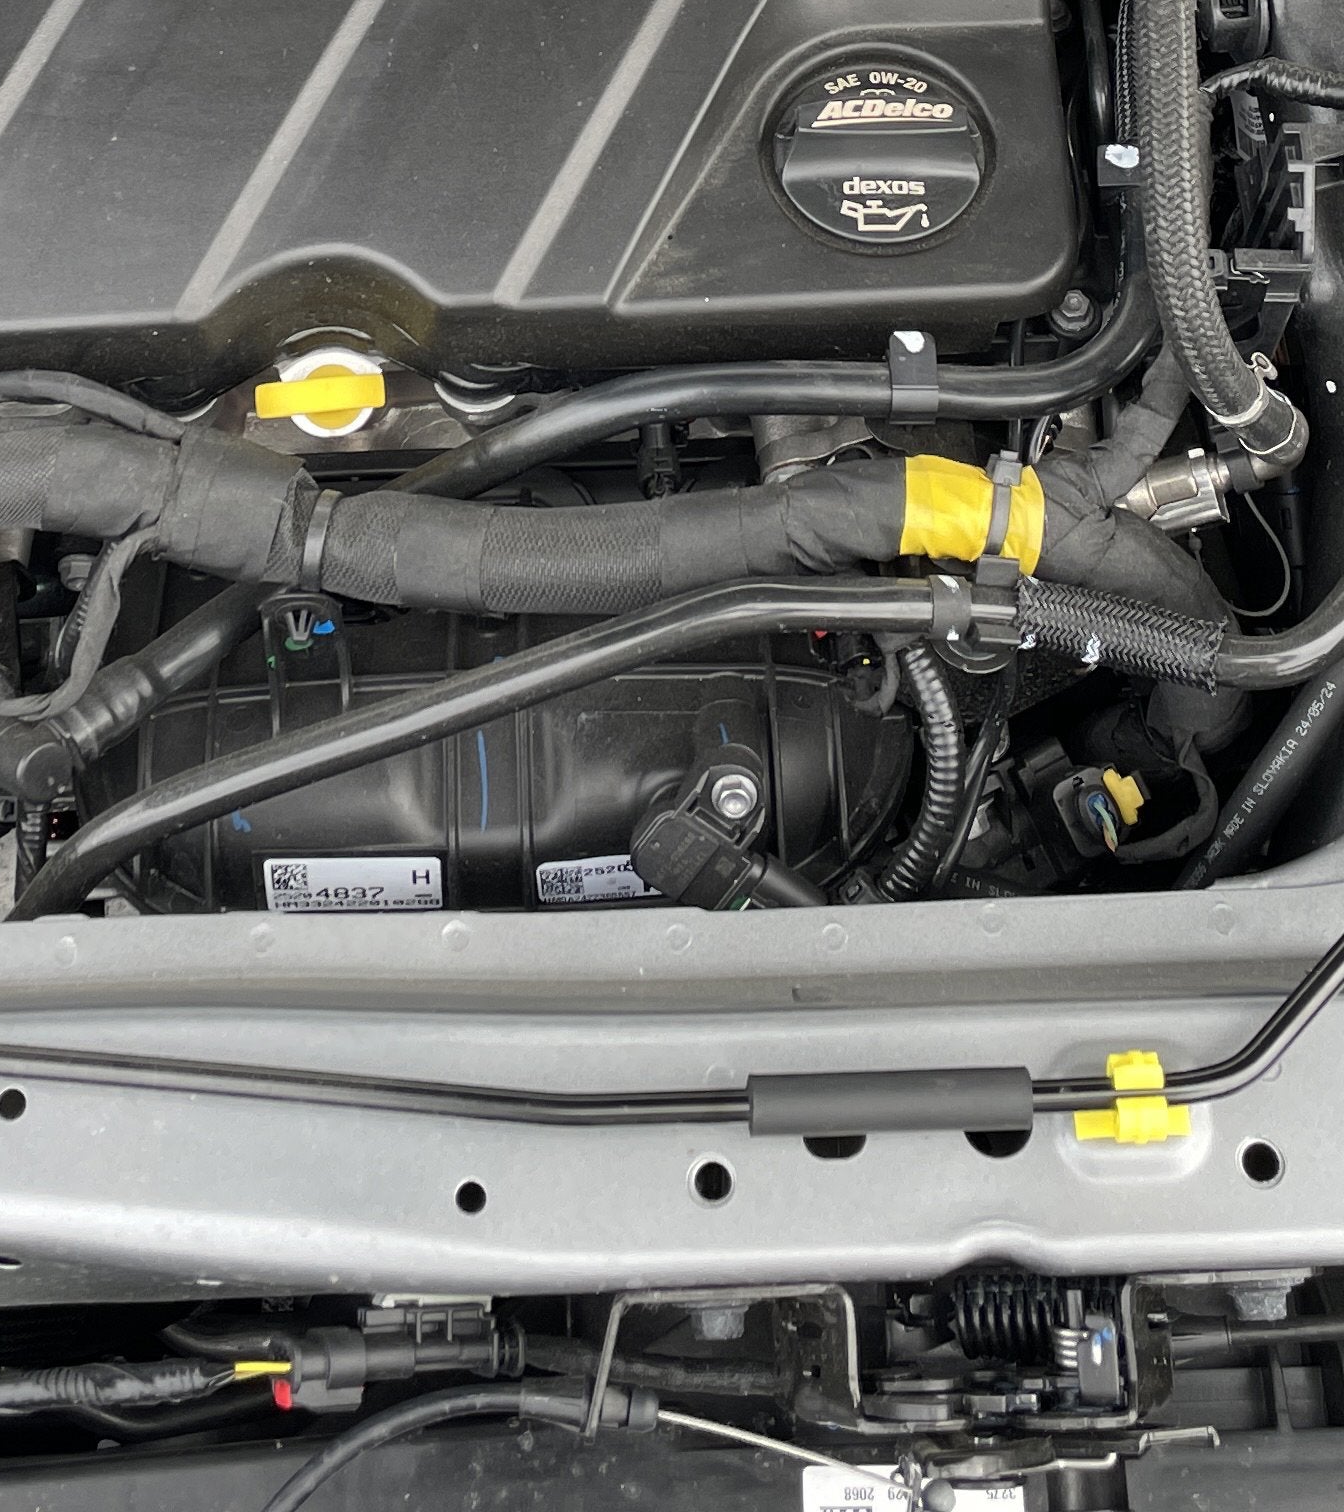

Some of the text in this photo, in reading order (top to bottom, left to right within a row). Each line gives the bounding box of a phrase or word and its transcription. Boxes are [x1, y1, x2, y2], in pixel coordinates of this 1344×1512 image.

[824, 71, 928, 95] SAE 0W-20
[816, 98, 954, 121] ACDelco
[842, 176, 926, 196] dexos
[1241, 796, 1256, 814] IN
[1252, 737, 1299, 796] SLOVAKIA
[411, 868, 431, 886] H
[315, 885, 385, 901] 4837
[844, 1486, 875, 1501] 2068
